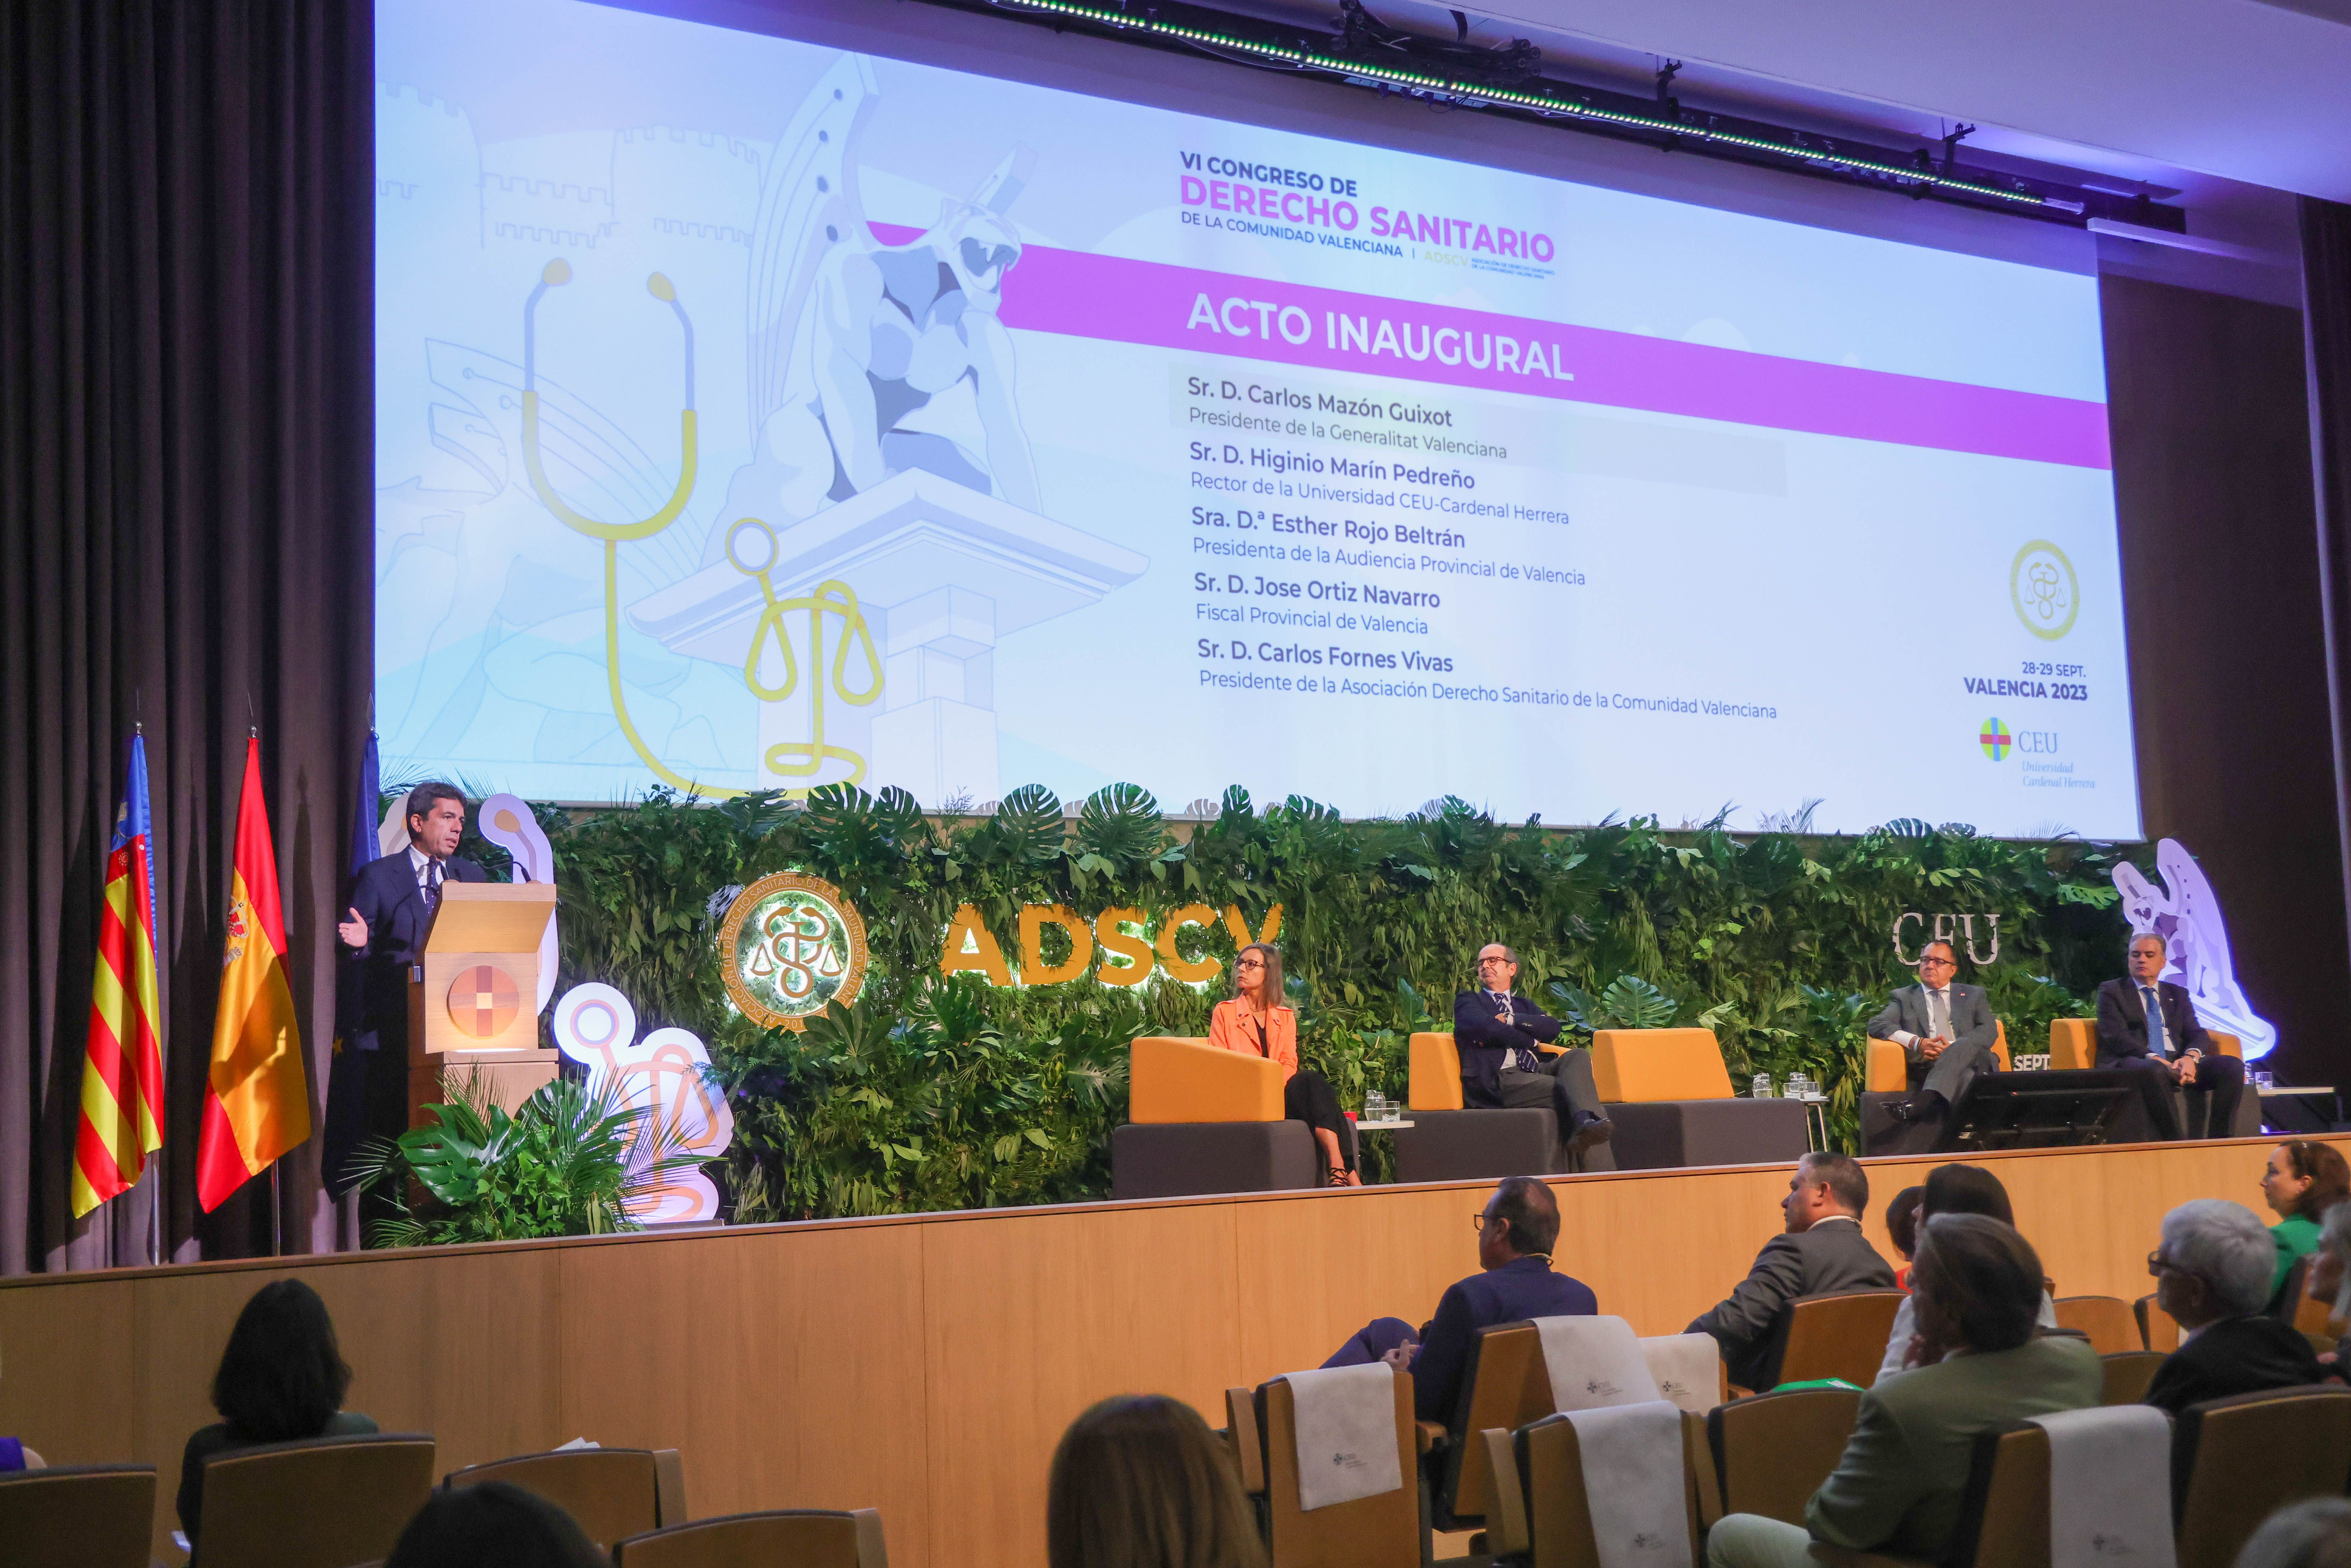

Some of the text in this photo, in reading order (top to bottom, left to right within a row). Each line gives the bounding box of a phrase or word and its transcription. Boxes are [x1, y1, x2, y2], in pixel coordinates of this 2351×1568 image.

[1180, 151, 1357, 197] VI CONGRESO DE
[1181, 175, 1555, 262] DERECHO SANITARIO
[1182, 211, 1403, 257] DE LA COMUNIDAD VALENCIANA
[1425, 250, 1469, 266] ADSCV
[1187, 293, 1574, 381] ACTO INAUGURAL
[1188, 376, 1453, 427] Sr. D. Carlos Mazón Guixot
[1190, 407, 1507, 459] Presidente de la Generalitat Valenciana
[1190, 441, 1475, 489] Sr. D. Higinio Marín Pedreño
[1192, 472, 1569, 524] Rector de la Universidad CEU-Cardenal Herrera
[1192, 506, 1230, 527] Sra.
[1272, 513, 1338, 536] Esther
[1345, 520, 1389, 544] Rojo
[1395, 524, 1465, 548] Beltrán
[1194, 537, 1585, 585] Presidenta de la Audiencia Provincial de Valencia
[1194, 572, 1440, 608] Sr. D. Jose Ortiz Navarro
[1197, 603, 1428, 634] Fiscal Provincial de Valencia
[1198, 638, 1453, 672] Sr. D. Carlos Fornes Vivas
[2022, 661, 2086, 677] 28-29 SEPT.
[1200, 670, 1777, 719] Presidente de la Asociación Derecho Sanitario de la Comunidad Valenciana
[1964, 677, 2088, 701] VALENCIA 2023
[2018, 731, 2058, 754] CEU
[2022, 761, 2073, 773] Universidad
[2023, 776, 2095, 789] Cardenal Herrera
[750, 877, 804, 899] SANITARIO
[806, 879, 820, 890] DE
[822, 886, 833, 898] LA
[723, 897, 750, 948] DERECHO
[835, 896, 863, 962] COMUNIDAD
[723, 951, 732, 967] DE
[785, 1019, 803, 1028] 201
